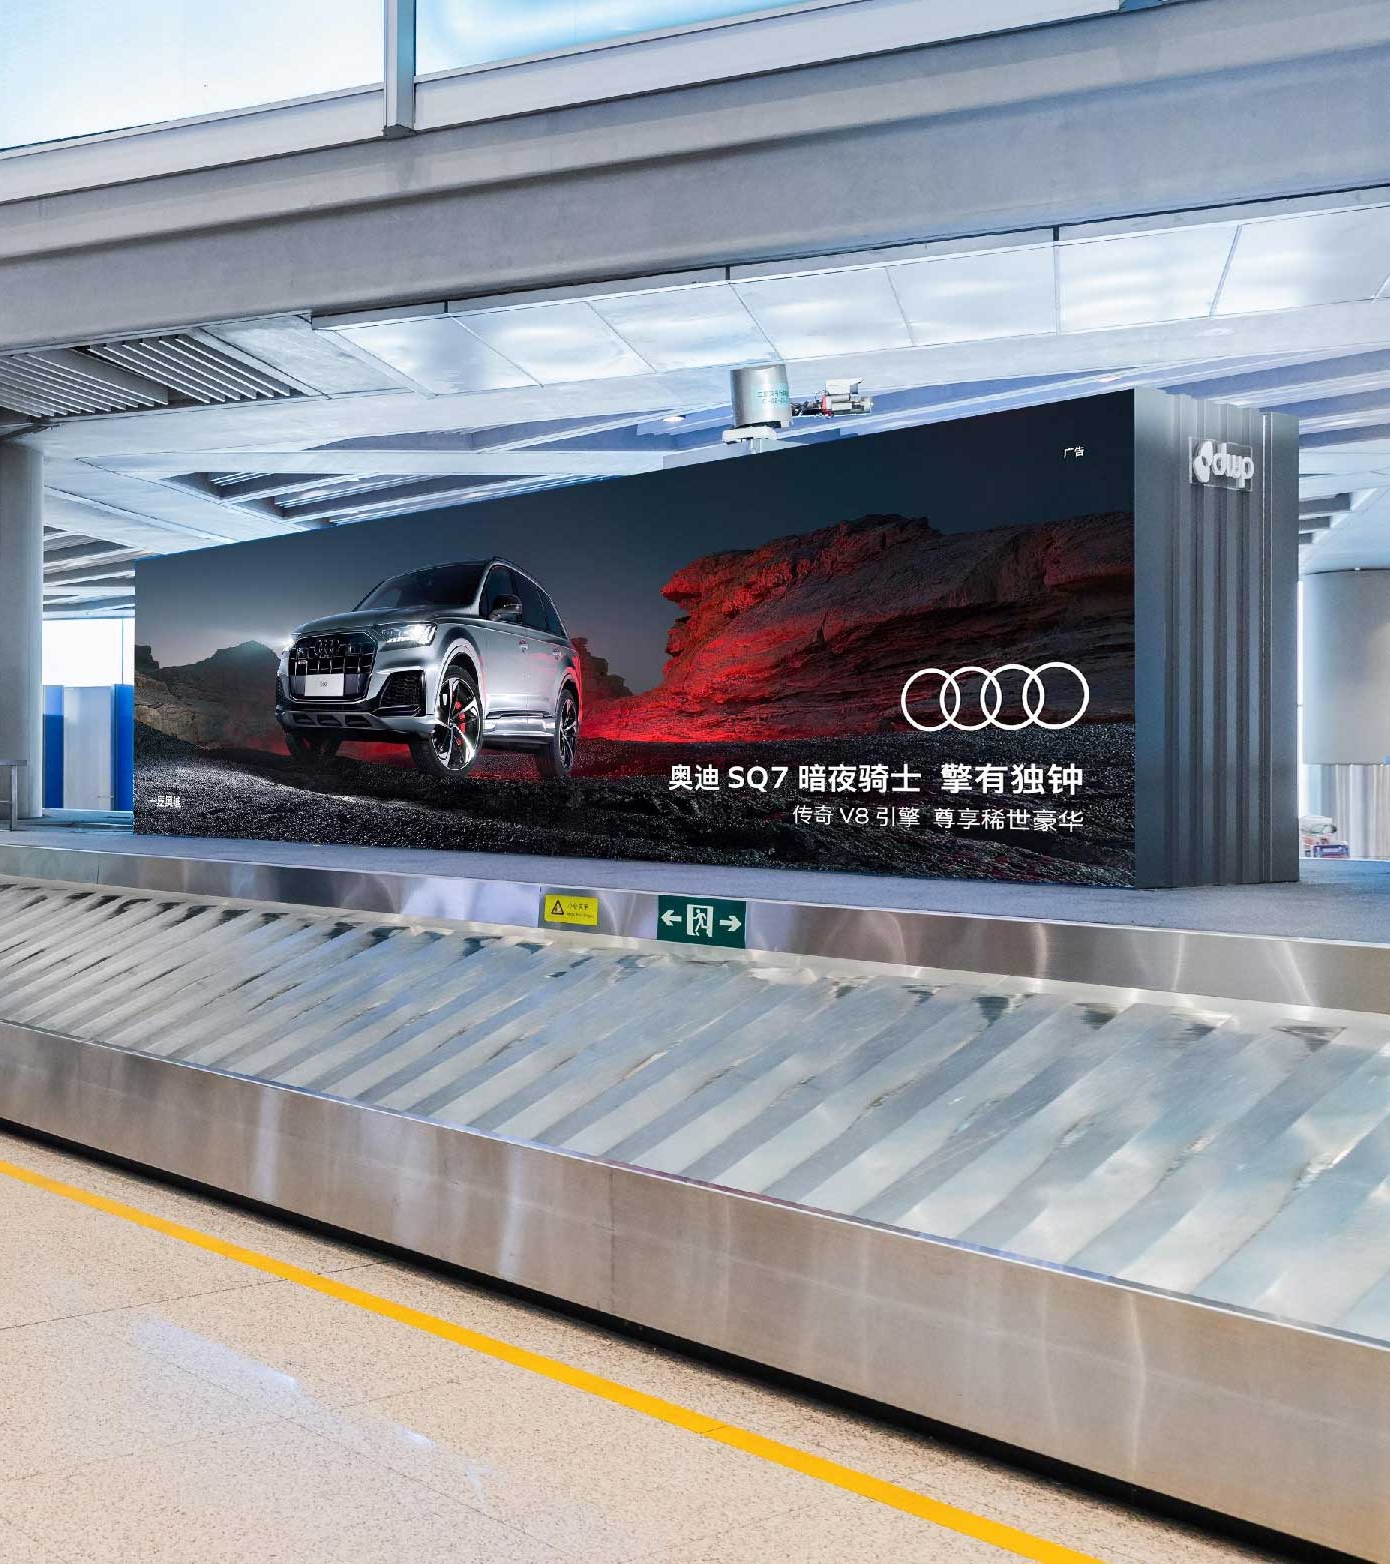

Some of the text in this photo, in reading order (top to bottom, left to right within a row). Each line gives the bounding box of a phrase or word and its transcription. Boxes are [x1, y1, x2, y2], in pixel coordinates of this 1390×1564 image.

[1063, 446, 1085, 459] 广告
[669, 763, 1083, 796] 奥迪 SQ7 暗夜骑士 擎有独钟
[792, 805, 1084, 832] 传奇 V8 引擎 尊享稀世豪华
